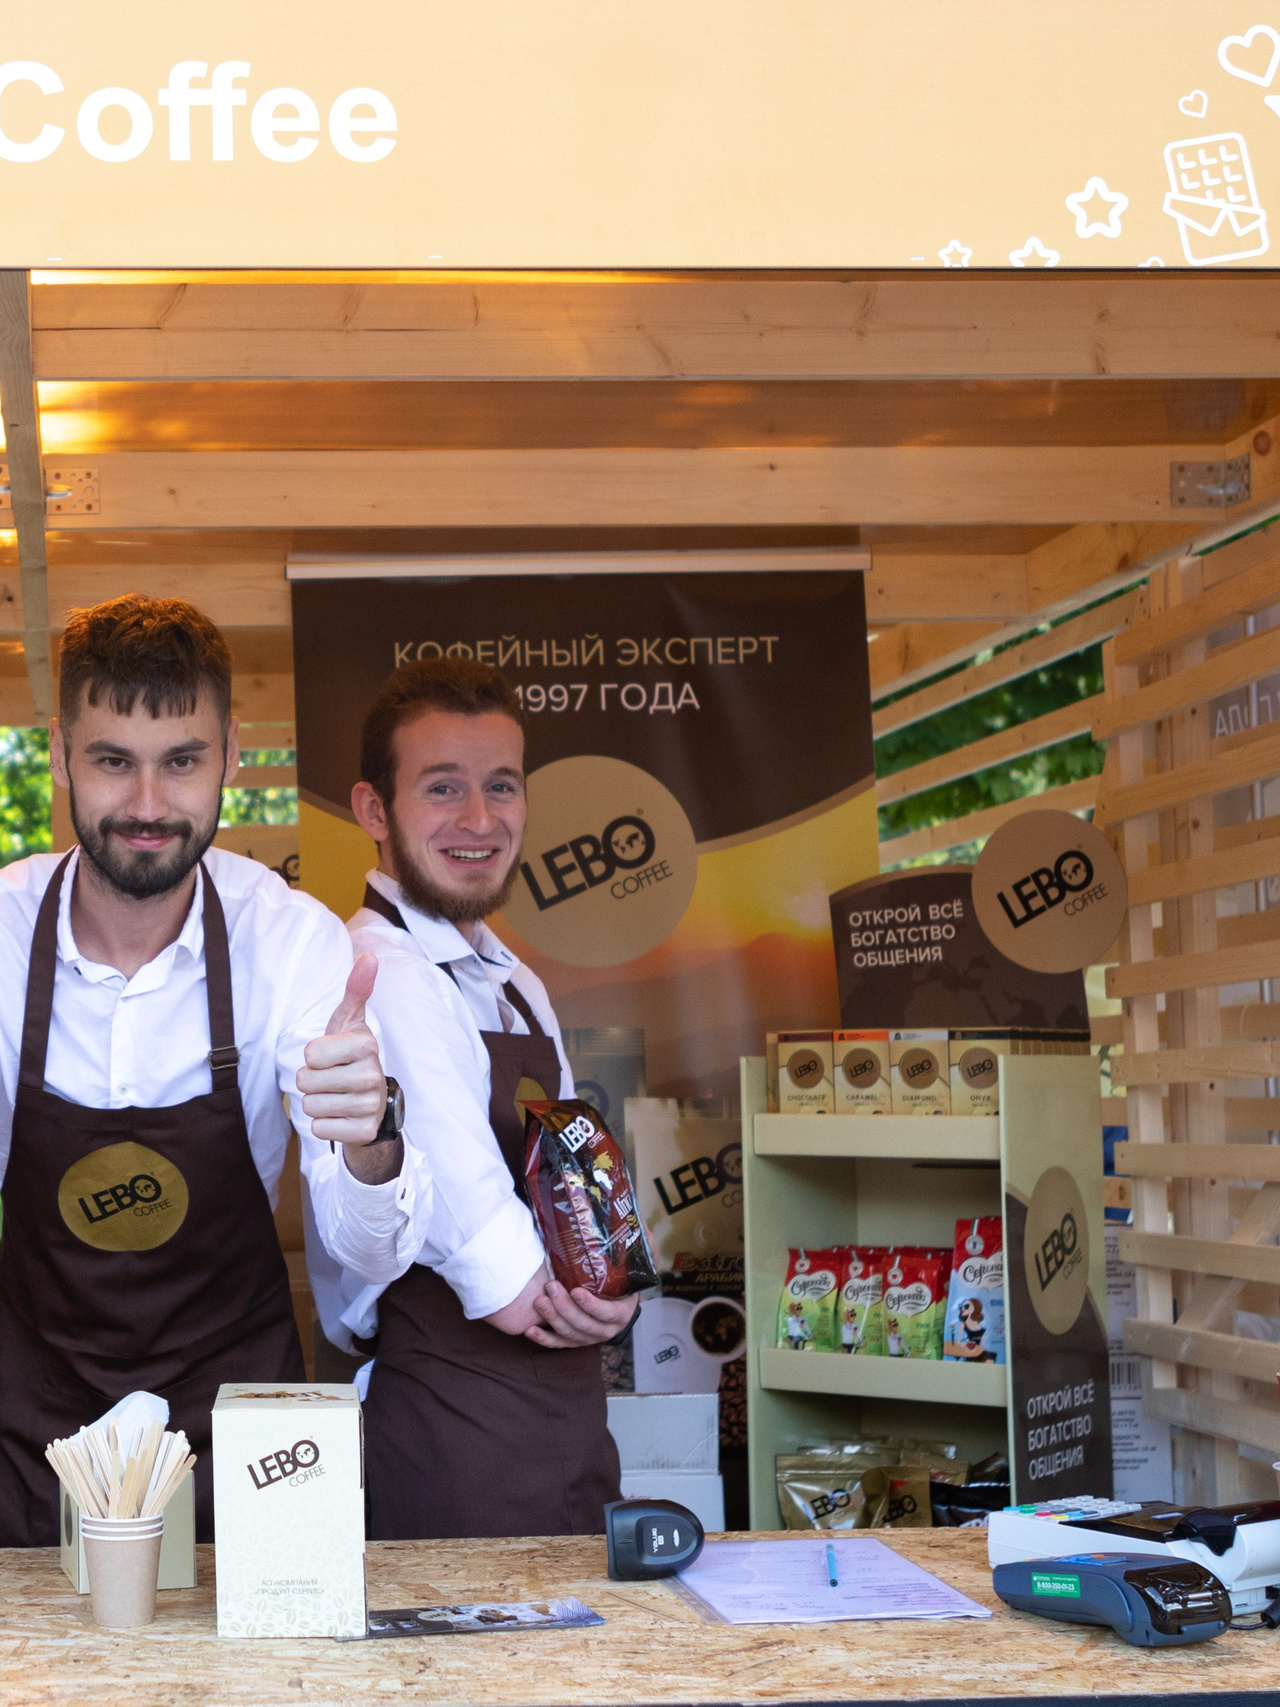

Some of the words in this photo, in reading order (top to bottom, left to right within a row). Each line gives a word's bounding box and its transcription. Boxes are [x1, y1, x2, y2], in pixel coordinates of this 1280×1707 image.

[394, 634, 605, 668] КОФЕЙНЫЙ
[616, 636, 780, 666] ЭКСПЕРТ
[514, 684, 589, 713] 1997
[600, 682, 701, 715] ГОДА
[520, 815, 657, 912] LEBO
[610, 859, 674, 900] COFFEE
[996, 849, 1095, 930] LEBO
[1063, 882, 1110, 918] COFFEE
[848, 902, 922, 929] ОТКРОЙ
[929, 899, 965, 921] ВСЁ
[850, 923, 957, 948] БОГАТСТВО
[853, 945, 944, 969] ОБЩЕНИЯ
[794, 1060, 818, 1079] LEBO
[849, 1059, 874, 1079] LEBO
[906, 1059, 932, 1079] LEBO
[966, 1058, 994, 1079] LEBO
[558, 1115, 596, 1154] LEBO
[653, 1142, 743, 1217] LEBO
[77, 1174, 163, 1224] LEBO
[133, 1198, 173, 1218] COFFEE
[1034, 1211, 1078, 1292] LEBO
[653, 1345, 680, 1365] LEBO
[1027, 1384, 1073, 1420] ОТКРОЙ
[1073, 1378, 1095, 1407] ВСЁ
[1028, 1412, 1092, 1452] БОГАТСТВО
[247, 1440, 320, 1490] LEBO
[288, 1464, 326, 1487] COFFEE
[1028, 1444, 1085, 1481] ОБЩЕНИЯ
[806, 1488, 851, 1522] EBO
